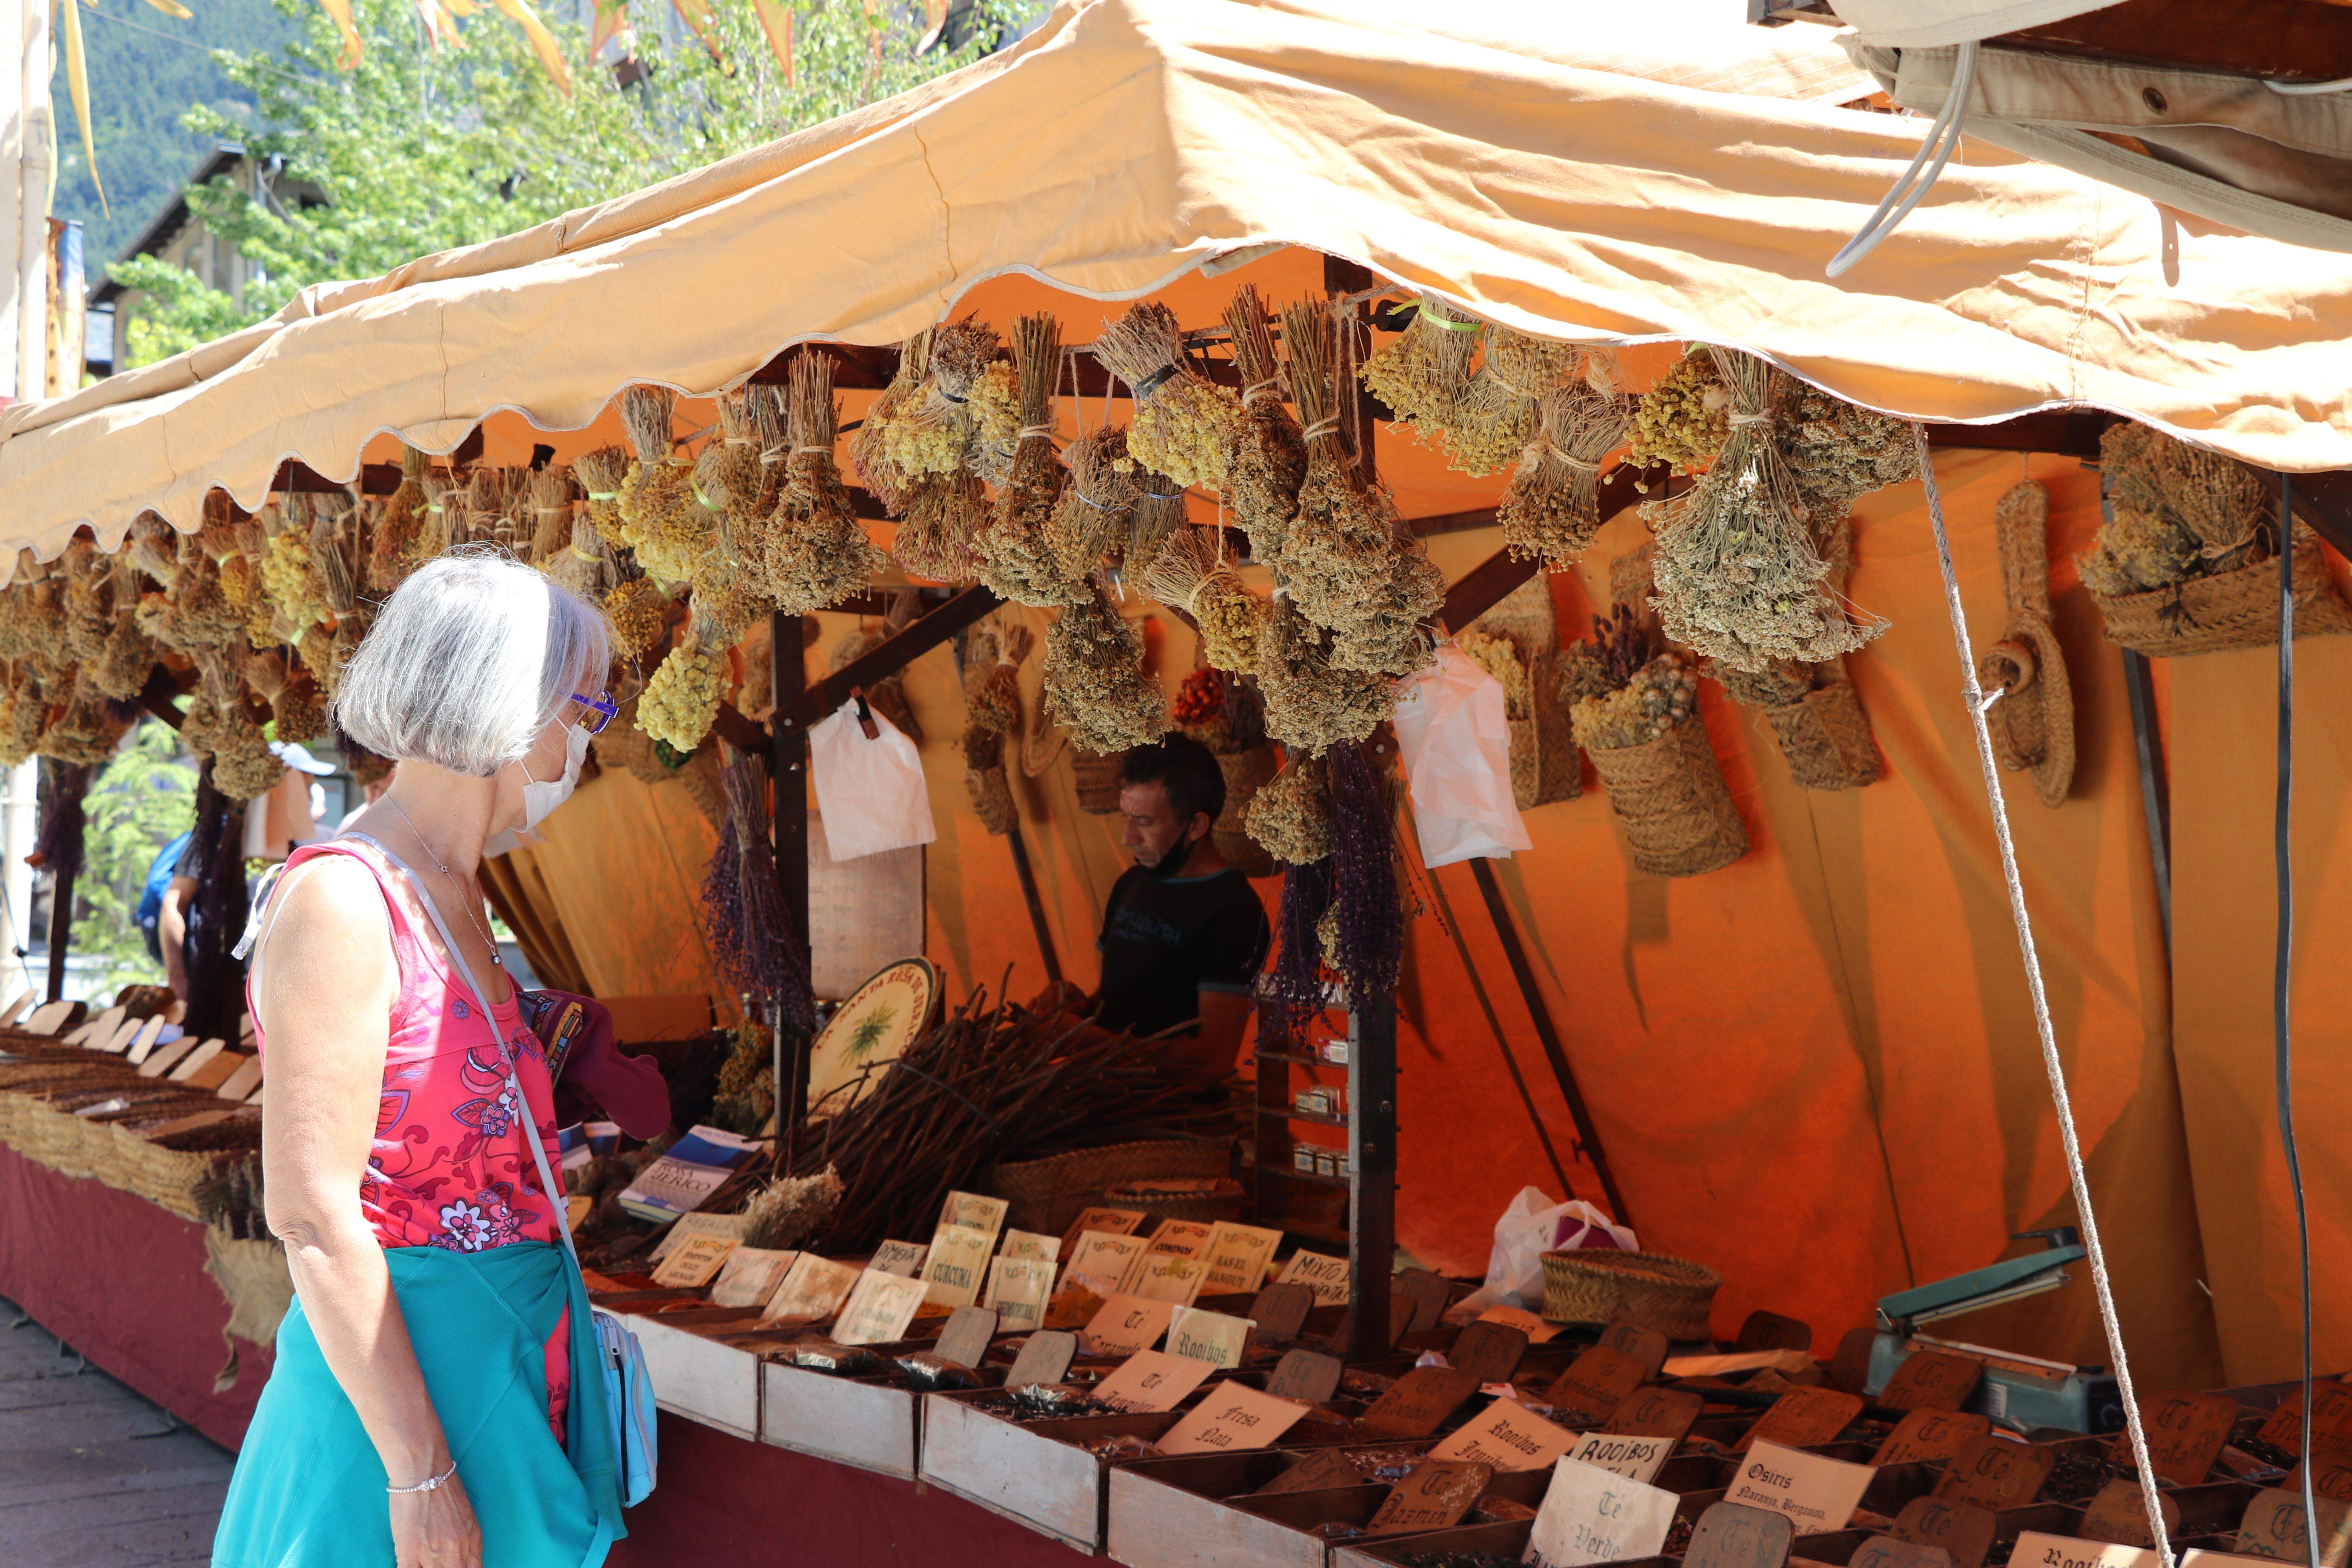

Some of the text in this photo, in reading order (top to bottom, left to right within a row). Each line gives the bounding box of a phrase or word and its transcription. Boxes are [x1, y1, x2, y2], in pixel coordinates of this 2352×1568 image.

[839, 979, 883, 1022] SANTA
[887, 969, 914, 985] ROSA
[656, 1161, 694, 1178] ROSA
[651, 1174, 710, 1192] JERICO
[1154, 1243, 1194, 1255] COMINOS
[1216, 1255, 1247, 1270] RAS EL
[1207, 1269, 1246, 1288] HANOUT
[1124, 1310, 1151, 1329] Té
[1177, 1332, 1229, 1364] Rooibos
[1141, 1374, 1170, 1389] Té
[1216, 1405, 1261, 1428] Fresa
[1194, 1427, 1233, 1447] Nata
[1488, 1420, 1543, 1455] Rooibos
[1748, 1463, 1795, 1489] Osiris
[1599, 1490, 1626, 1519] Té
[1573, 1524, 1621, 1561] Verde
